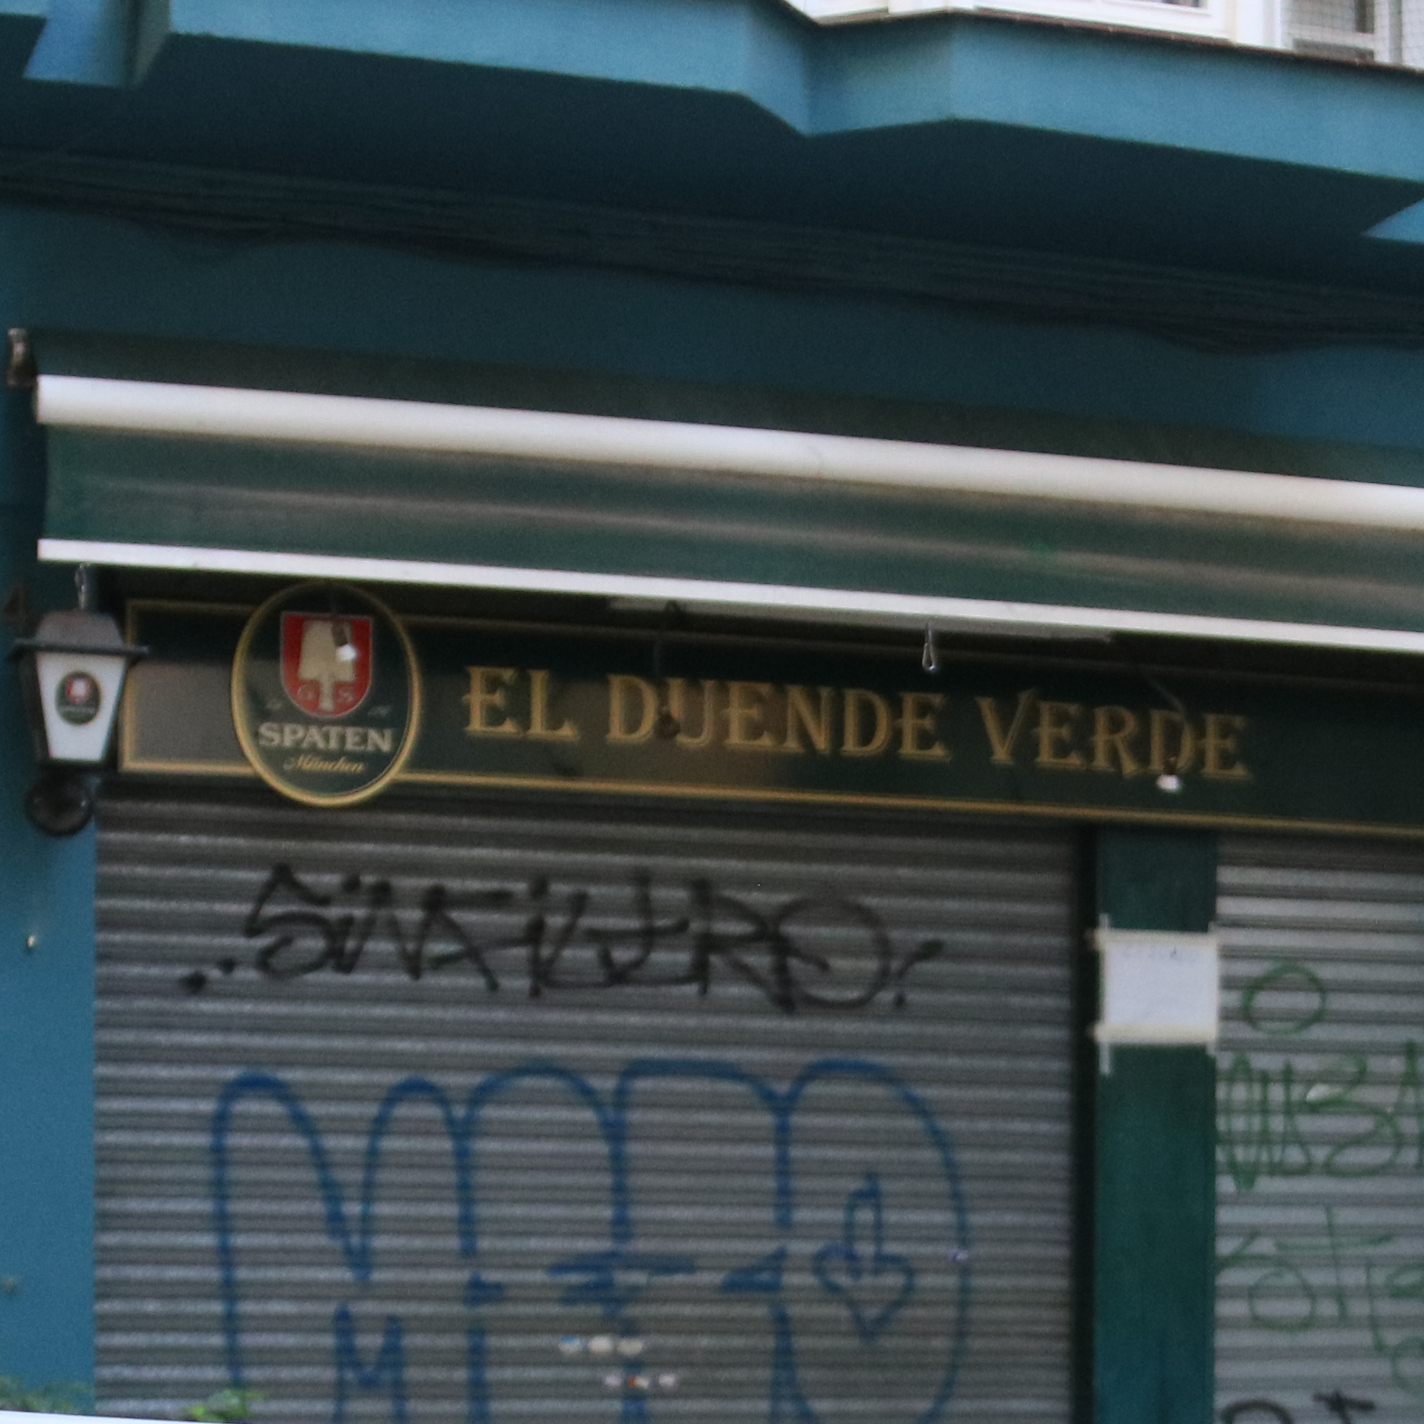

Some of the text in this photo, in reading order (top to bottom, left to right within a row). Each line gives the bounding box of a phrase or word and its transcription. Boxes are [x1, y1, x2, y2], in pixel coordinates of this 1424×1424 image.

[257, 722, 395, 754] SPATEN
[463, 666, 1253, 780] EL DUENDE VERDE
